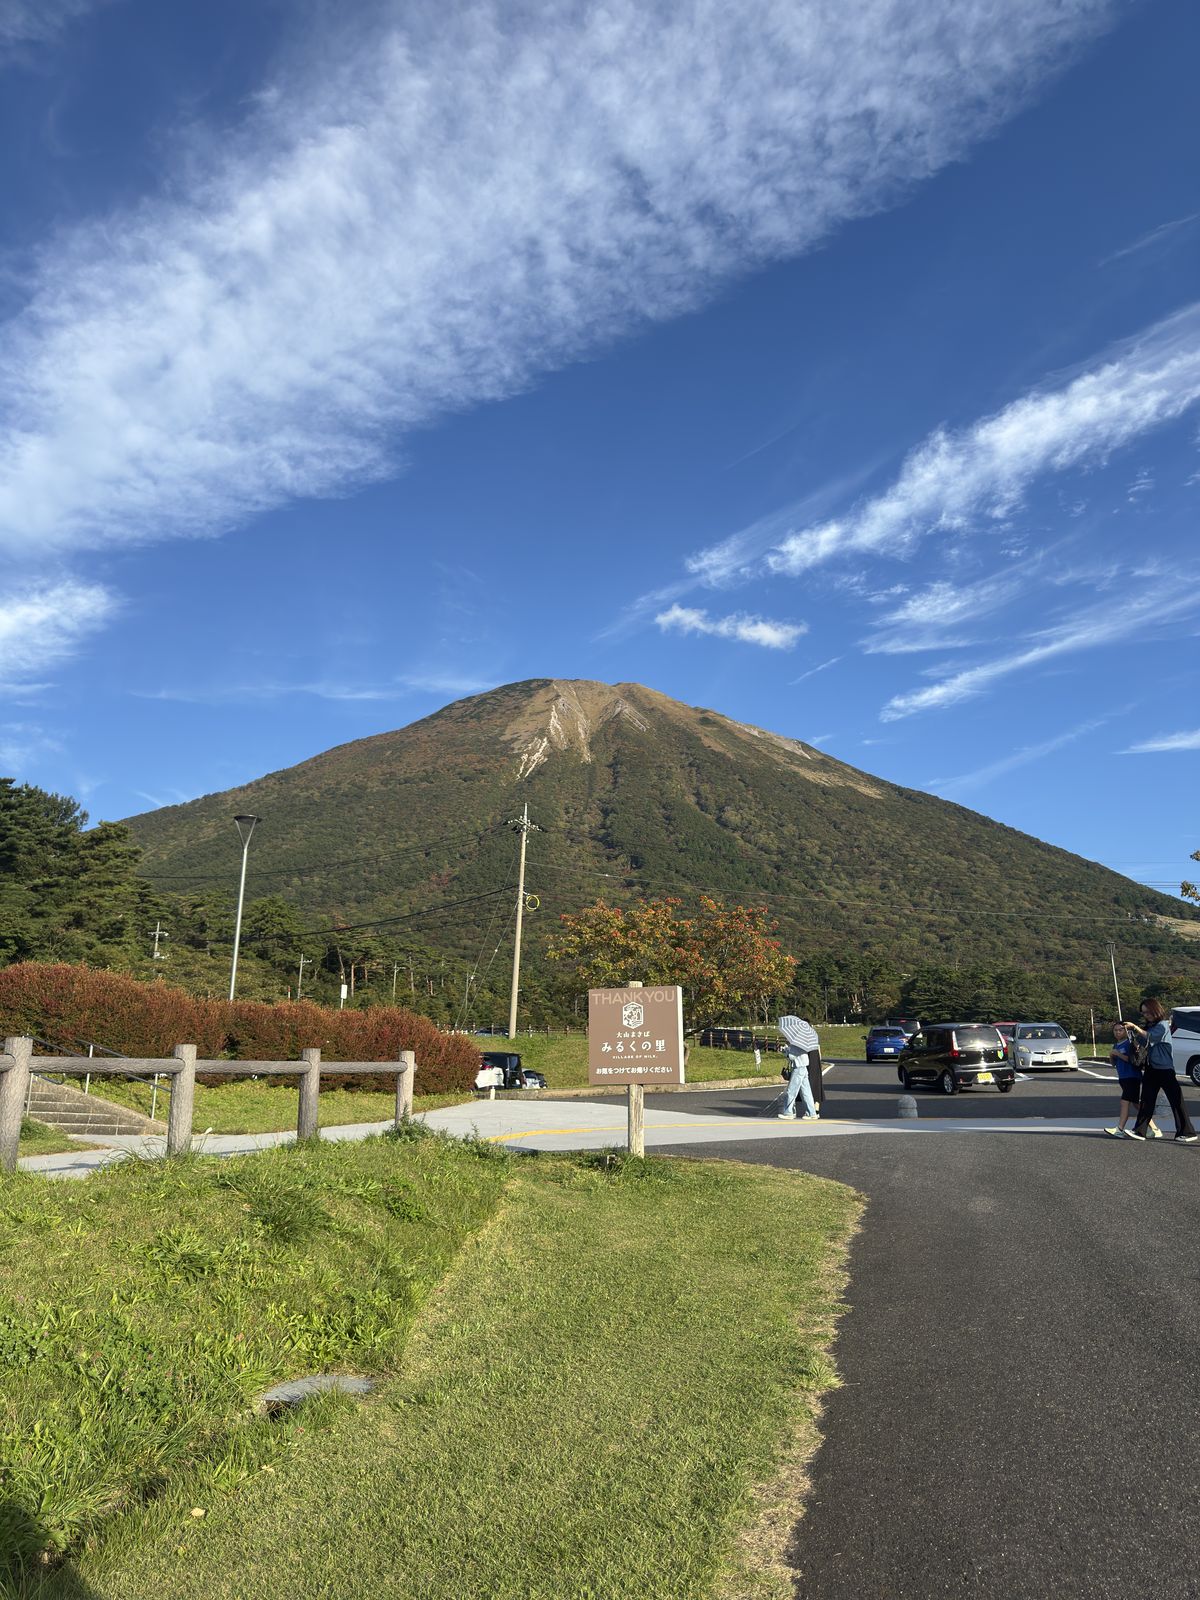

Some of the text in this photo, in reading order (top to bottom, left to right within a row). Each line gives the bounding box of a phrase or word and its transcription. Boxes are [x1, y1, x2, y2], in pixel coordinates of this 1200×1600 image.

[592, 990, 674, 1004] THANK YOU
[602, 1040, 666, 1052] みるくの里
